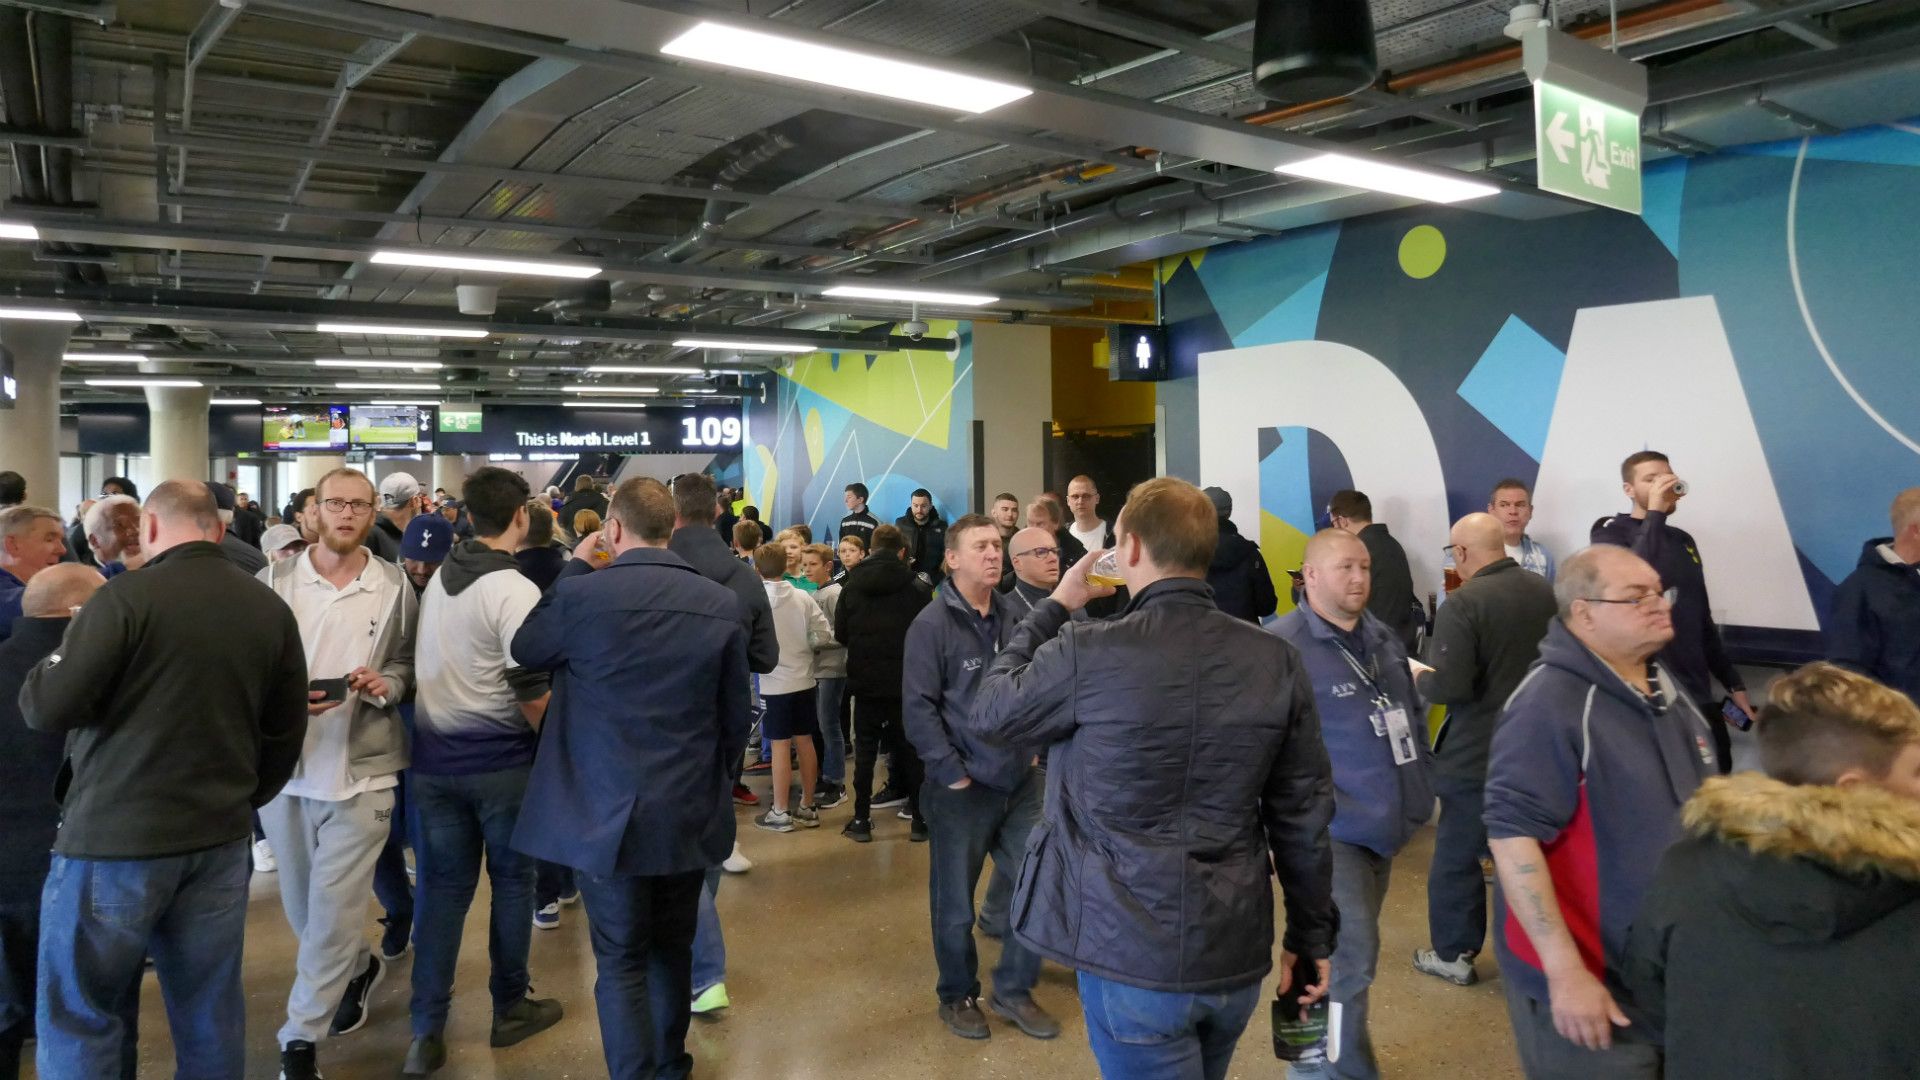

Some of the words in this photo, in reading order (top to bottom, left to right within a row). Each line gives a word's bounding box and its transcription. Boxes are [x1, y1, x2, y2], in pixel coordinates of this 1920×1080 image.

[1610, 141, 1636, 170] Exit
[516, 431, 544, 446] This
[546, 432, 558, 446] is
[560, 431, 601, 446] North
[603, 431, 639, 446] Level
[640, 431, 651, 446] 1
[681, 416, 741, 446] 109
